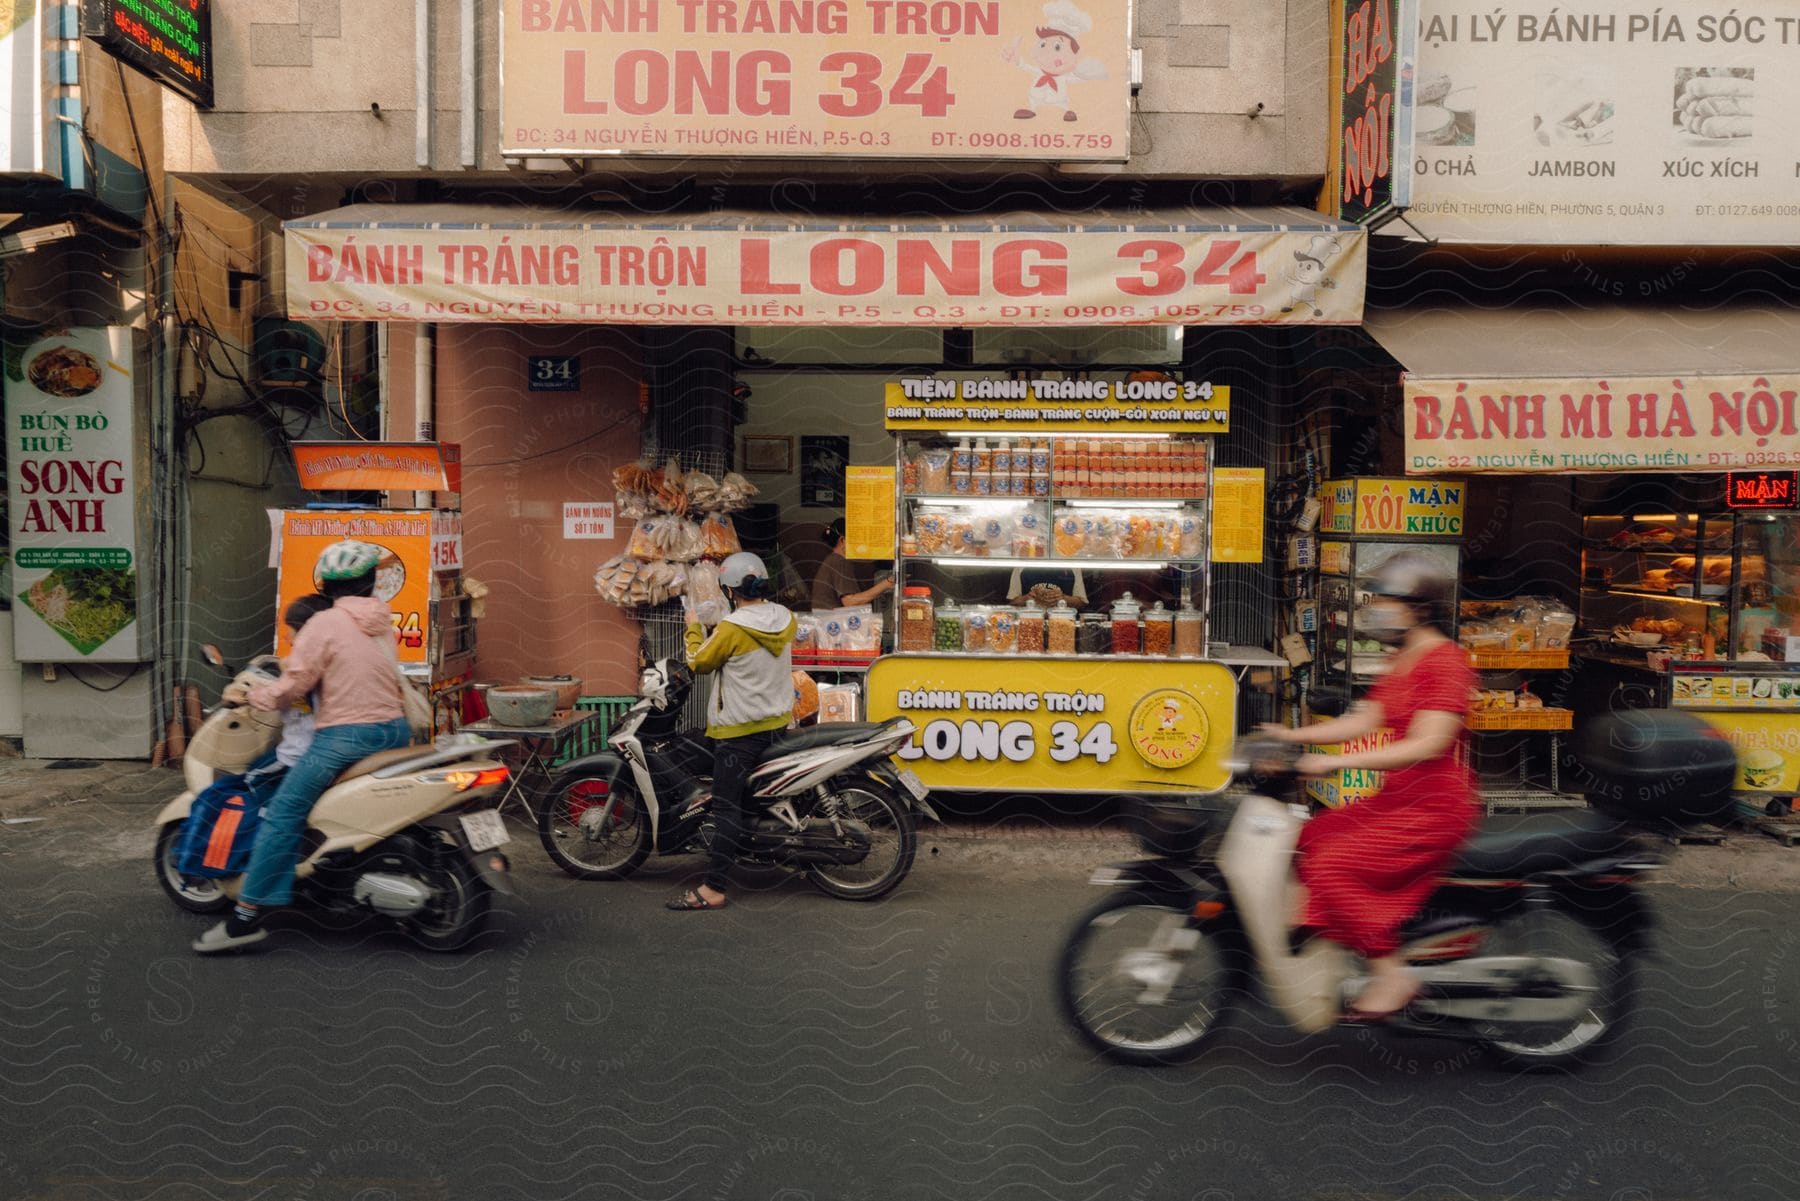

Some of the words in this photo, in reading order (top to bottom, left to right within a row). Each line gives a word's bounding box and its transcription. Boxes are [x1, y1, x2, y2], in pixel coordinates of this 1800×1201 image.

[1417, 14, 1457, 49] ẠI
[1471, 8, 1506, 43] LÝ
[1518, 8, 1616, 43] BÁNH
[1627, 8, 1686, 43] PÍA
[1696, 9, 1766, 44] SÓC
[1774, 17, 1800, 45] T
[562, 49, 792, 117] LONG
[817, 51, 956, 118] 34
[515, 128, 547, 144] ĐC:
[553, 128, 577, 144] 34
[584, 122, 668, 145] NGUYỄN
[674, 127, 759, 147] THƯỢNG
[931, 132, 963, 147] ĐT:
[968, 132, 1113, 149] 0908.105.759
[1344, 82, 1391, 208] NỘI
[1434, 154, 1477, 177] CHẢ
[1527, 160, 1616, 178] JAMBON
[1662, 156, 1704, 178] XÚC
[1709, 157, 1759, 179] XÍCH
[1655, 204, 1665, 217] 3
[1718, 204, 1800, 217] 0127.649.008
[307, 235, 423, 285] BÁNH
[438, 235, 579, 286] TRÁNG
[594, 236, 707, 296] TRỘN
[740, 238, 1068, 297] LONG
[1115, 239, 1267, 297] 34
[376, 301, 412, 314] 34
[838, 304, 881, 318] P.5
[913, 305, 966, 319] Q.3
[1000, 305, 1051, 318] ĐT:
[1063, 304, 1266, 318] 0908.105.759
[537, 359, 572, 380] 34
[900, 375, 957, 404] TIỆM
[962, 376, 1028, 400] BÁNH
[1030, 377, 1109, 401] TRÁNG
[1115, 380, 1178, 401] LONG
[1183, 380, 1214, 401] 34
[19, 409, 69, 431] BÚN
[75, 410, 109, 431] BÒ
[1413, 382, 1547, 440] BÁNH
[1560, 380, 1614, 440] MÌ
[1626, 378, 1697, 439] HÀ
[1708, 376, 1799, 448] NỘI
[1413, 454, 1443, 469] ĐC:
[1447, 454, 1472, 468] 32
[1476, 448, 1555, 468] NGUYỄN
[1561, 451, 1639, 470] THƯỢNG
[1708, 451, 1739, 466] ĐT:
[20, 459, 125, 494] SONG
[1735, 474, 1790, 504] MẶN
[19, 499, 106, 533] ANH
[1359, 483, 1405, 531] XÔI
[1408, 483, 1461, 509] MẶN
[1406, 511, 1461, 534] KHÚC
[432, 540, 459, 567] 15K
[897, 686, 961, 710] BÁNH
[964, 687, 1039, 712] TRÁNG
[1042, 688, 1105, 717] TRỘN
[895, 718, 1036, 763] LONG
[1048, 720, 1118, 764] 34
[1139, 736, 1183, 760] LONG
[1186, 733, 1202, 752] 34
